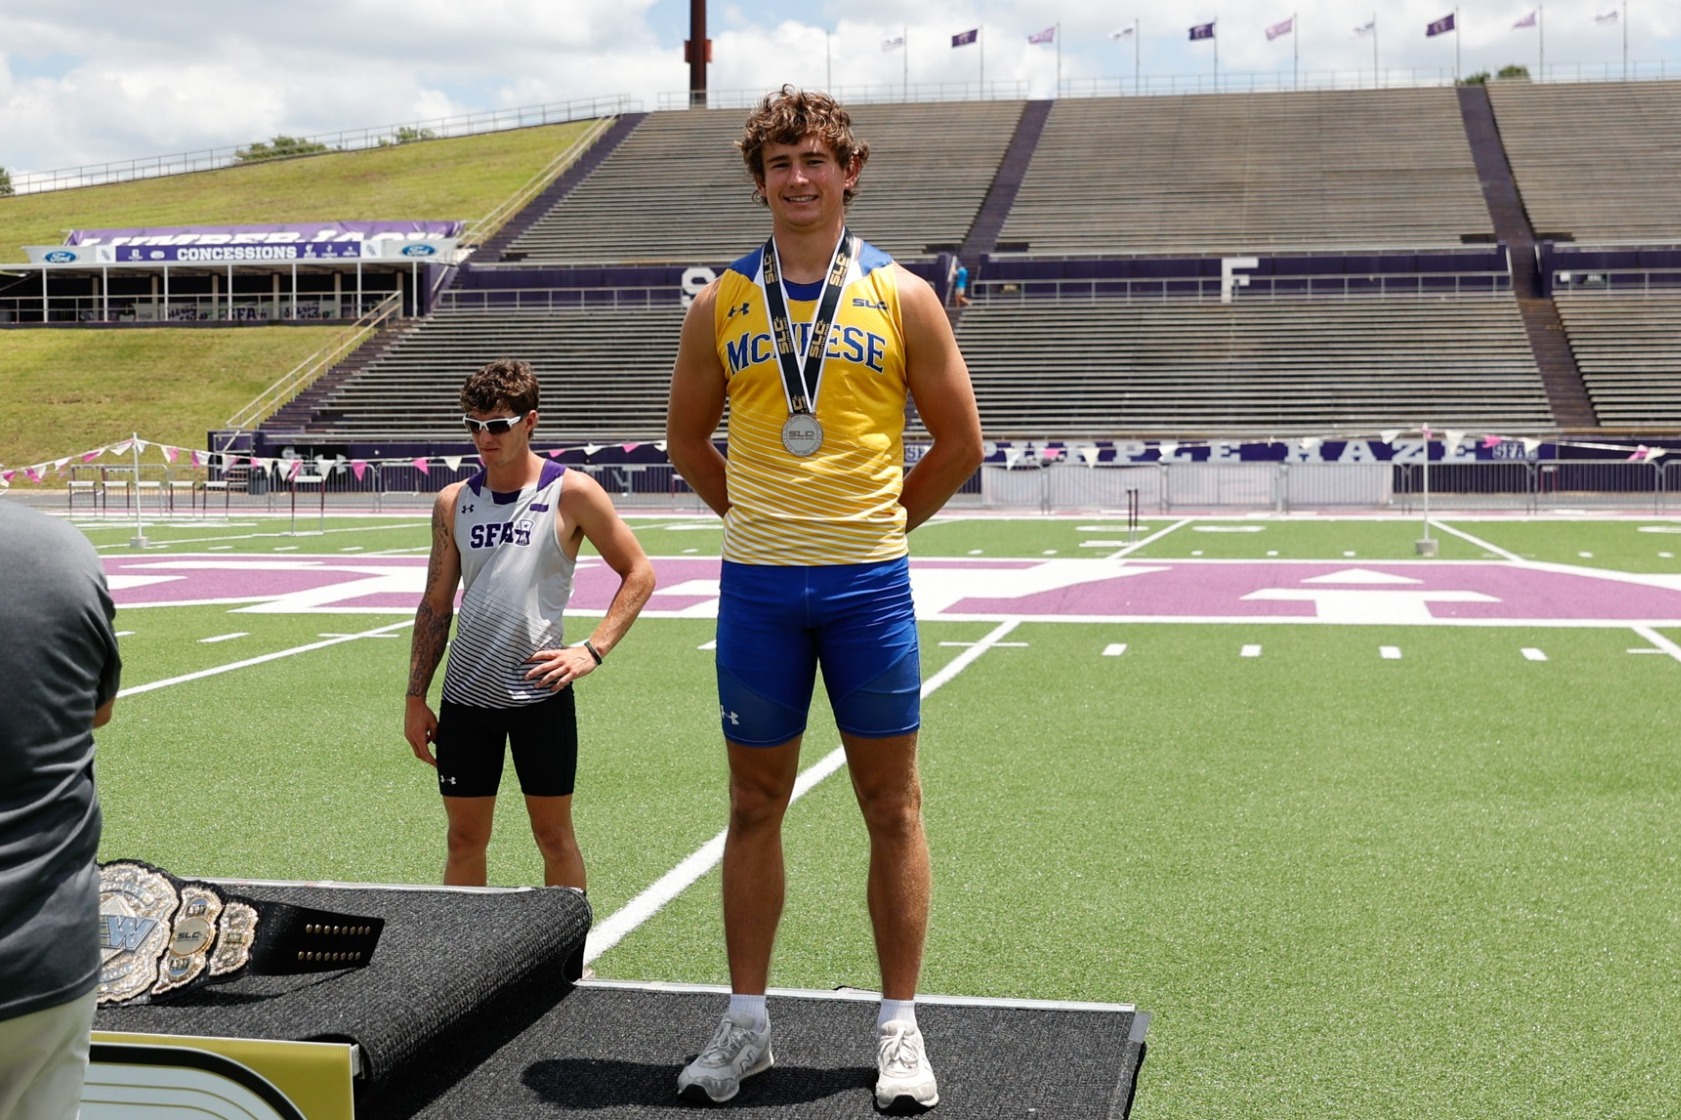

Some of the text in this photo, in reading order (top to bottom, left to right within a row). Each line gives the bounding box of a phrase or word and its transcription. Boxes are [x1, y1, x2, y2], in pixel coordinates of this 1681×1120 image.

[176, 246, 298, 261] CONCESSIONS
[764, 254, 775, 285] SLC
[829, 253, 848, 287] SLC
[1221, 257, 1259, 303] F
[727, 322, 886, 376] MCESE
[773, 318, 790, 355] SLC
[809, 321, 826, 358] SLC
[1286, 440, 1478, 463] HAZE
[469, 521, 514, 549] SFA
[177, 931, 201, 939] SLC
